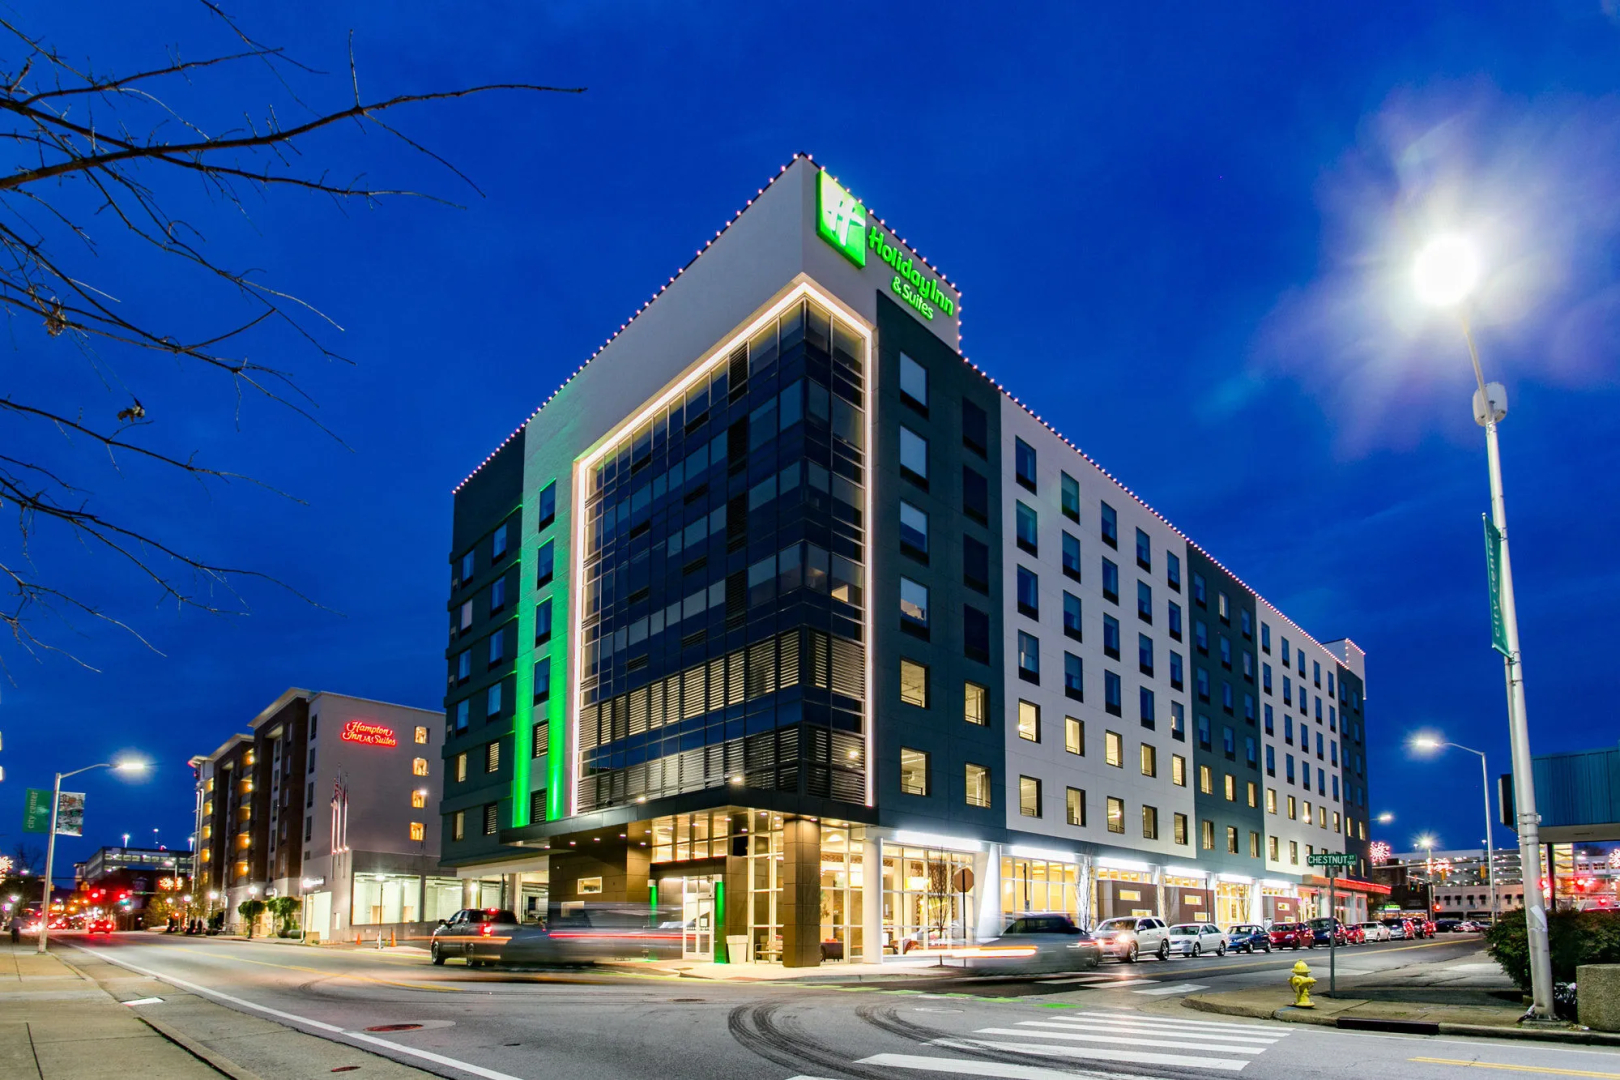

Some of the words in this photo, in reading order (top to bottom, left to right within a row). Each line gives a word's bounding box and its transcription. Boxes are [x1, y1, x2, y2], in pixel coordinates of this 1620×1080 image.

[868, 226, 931, 300] Holiday
[930, 279, 954, 316] Inn
[891, 275, 902, 295] &
[902, 283, 934, 321] Suites
[346, 721, 393, 736] Hampton
[342, 731, 364, 742] Inn
[374, 735, 396, 746] Suites
[27, 815, 37, 829] city
[1308, 855, 1347, 864] CHESTNUT
